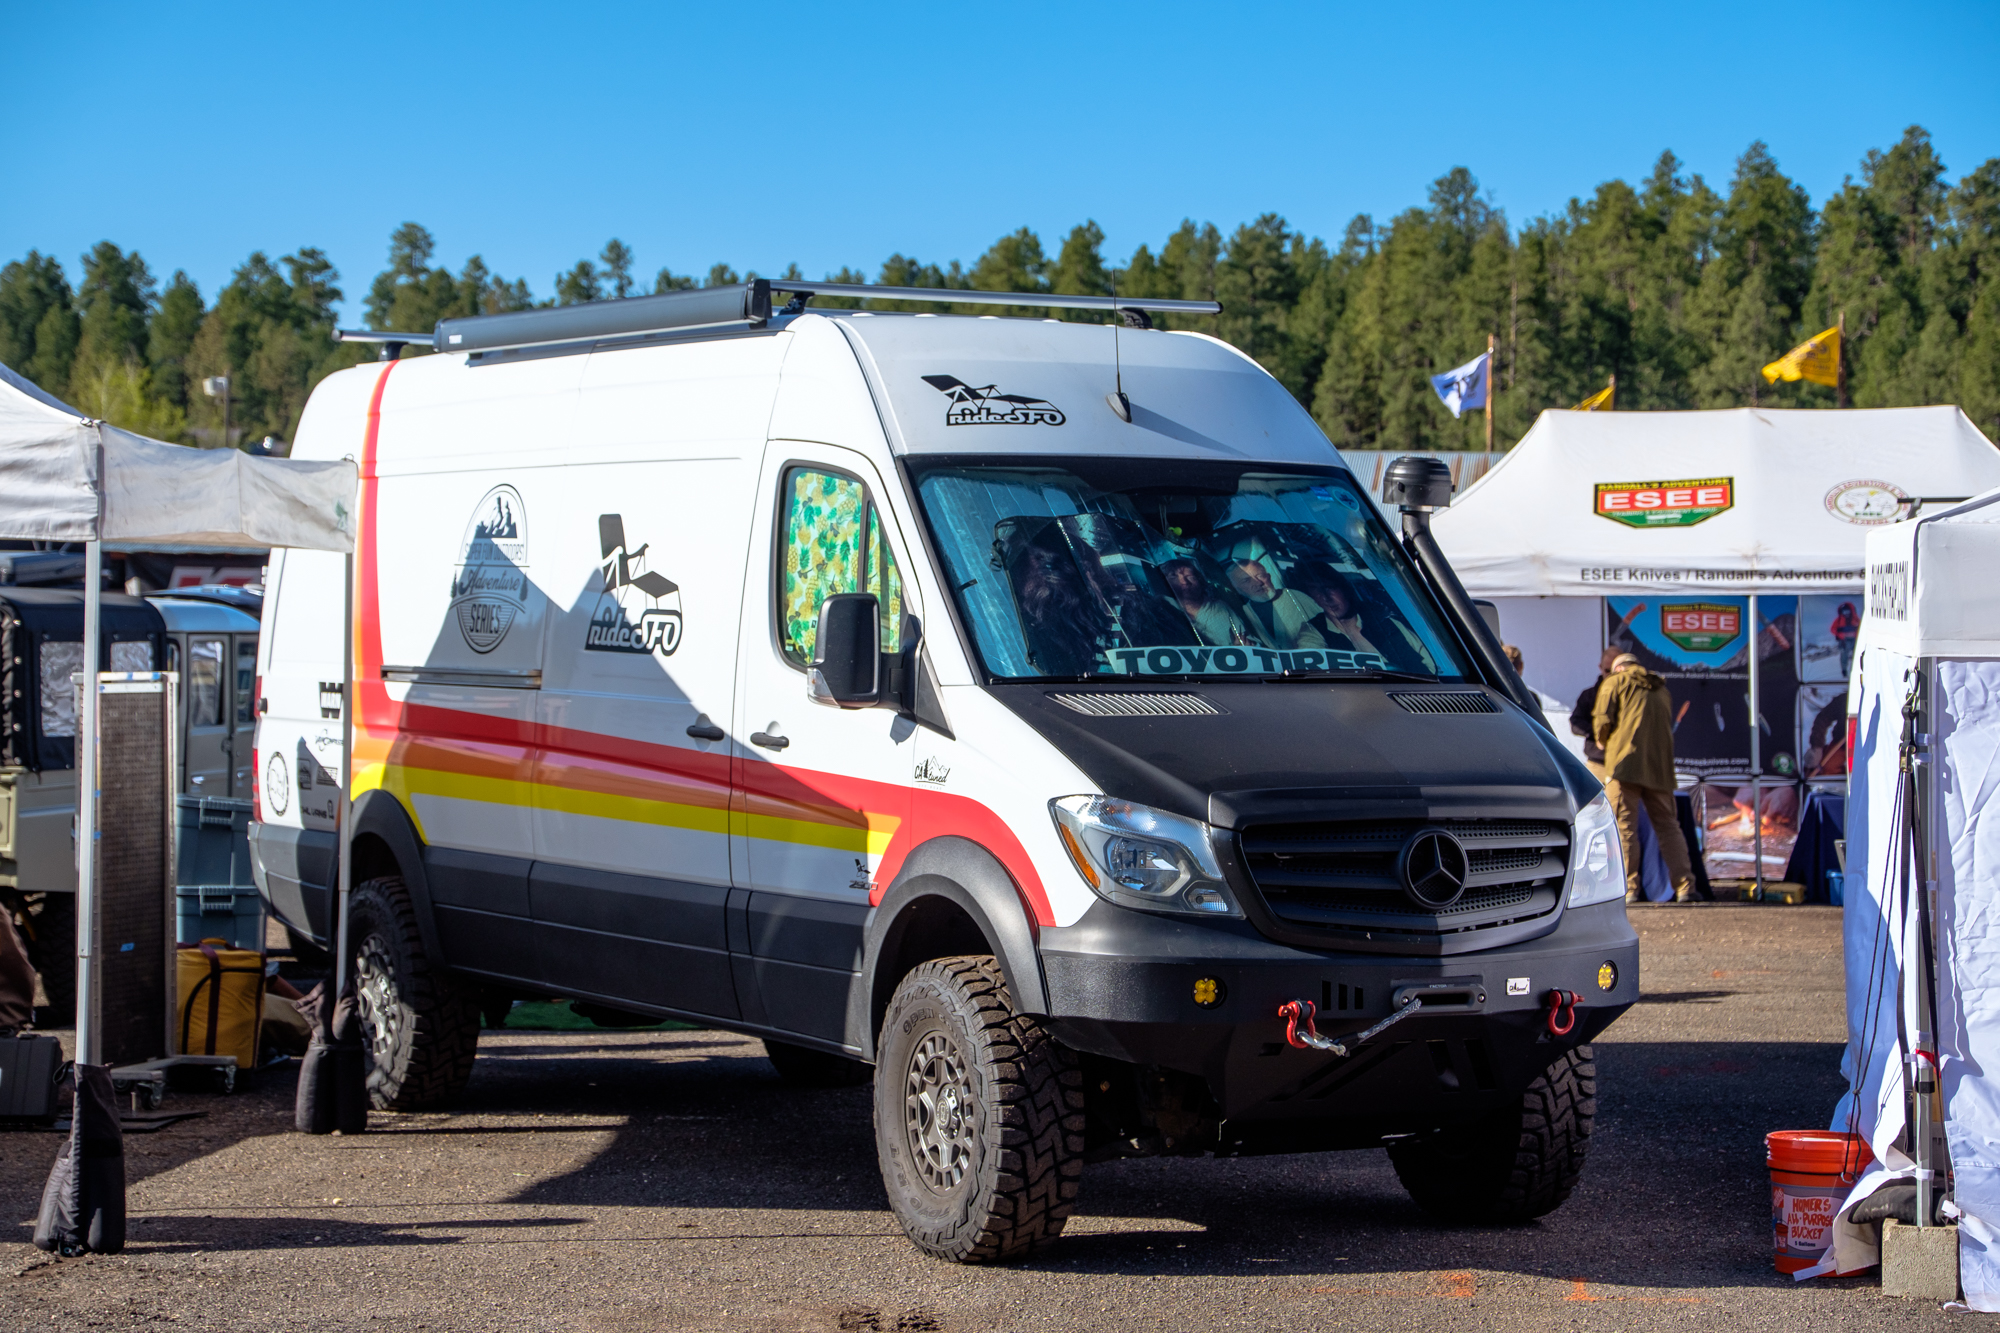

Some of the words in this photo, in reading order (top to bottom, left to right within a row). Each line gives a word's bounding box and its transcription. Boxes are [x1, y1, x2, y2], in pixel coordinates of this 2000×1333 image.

[1661, 478, 1730, 489] ADVENTURE
[1604, 487, 1724, 509] ESEE
[465, 542, 482, 561] SUPER
[482, 543, 494, 561] FUN
[494, 543, 525, 561] OUTDOORS
[457, 561, 521, 595] Adventure
[1581, 568, 1623, 581] ESEE
[1628, 568, 1681, 582] Knives
[1695, 568, 1767, 582] Randall's
[1772, 569, 1854, 582] Adventure
[469, 603, 501, 634] SERIES
[1667, 613, 1736, 631] ESEE
[1115, 648, 1248, 674] TOYO
[1252, 649, 1387, 671] TIRES
[903, 1007, 935, 1036] OPEN
[1793, 1197, 1831, 1213] HOMER'S
[1791, 1226, 1824, 1240] BUCKET
